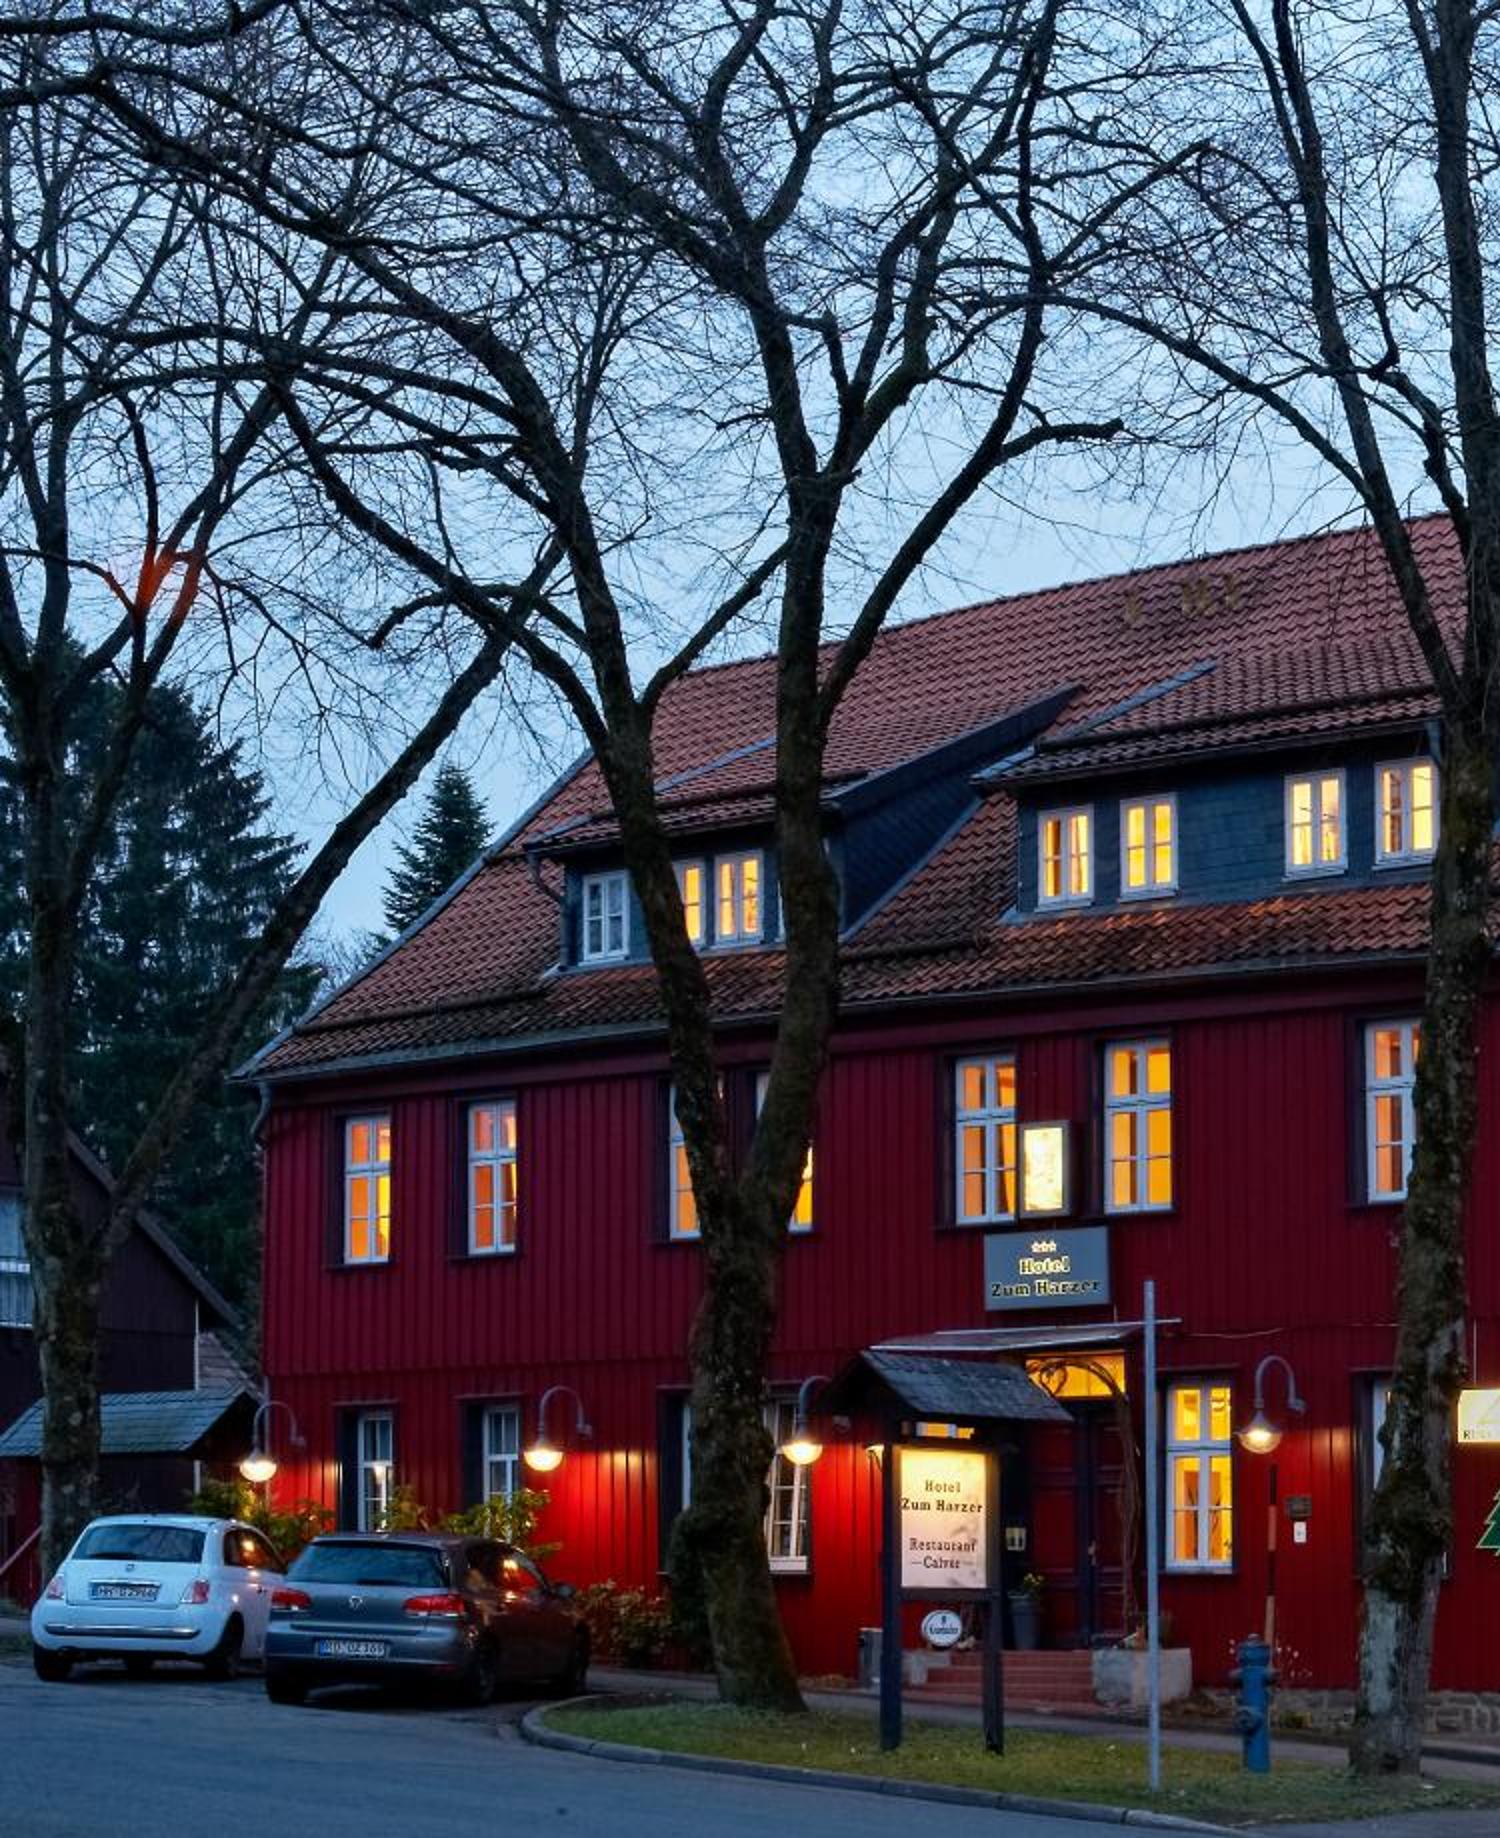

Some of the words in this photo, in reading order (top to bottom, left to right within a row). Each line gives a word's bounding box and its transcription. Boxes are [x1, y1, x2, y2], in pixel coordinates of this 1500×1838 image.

[1019, 1255, 1071, 1275] Hotel
[991, 1283, 1031, 1297] Zum
[1035, 1279, 1101, 1296] Harzer
[925, 1479, 961, 1493] Hotel
[902, 1497, 931, 1511] Zum
[936, 1499, 983, 1513] Harzer
[909, 1538, 977, 1552] Restaurant
